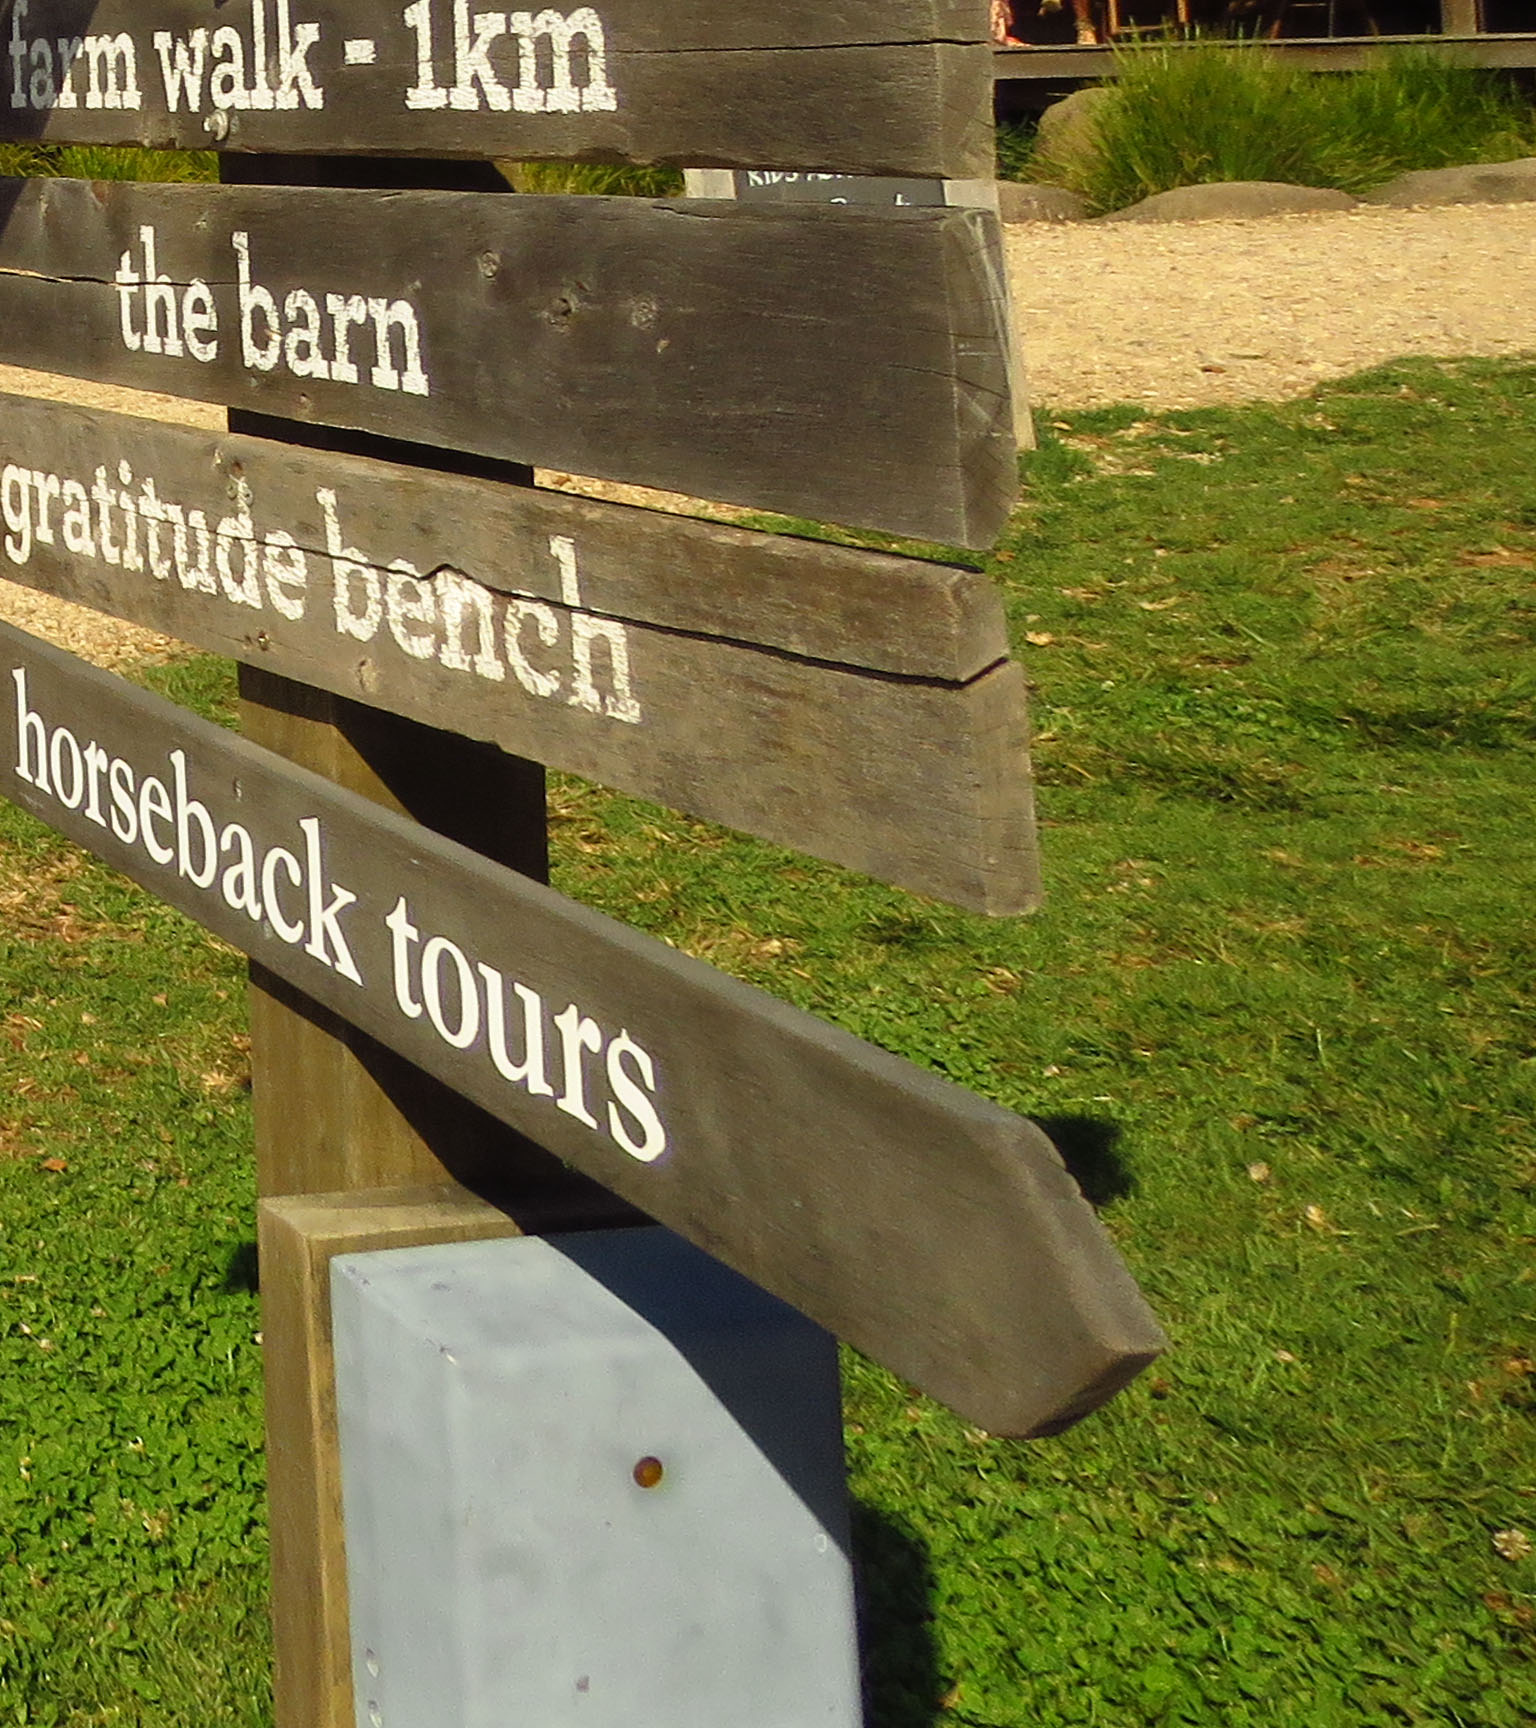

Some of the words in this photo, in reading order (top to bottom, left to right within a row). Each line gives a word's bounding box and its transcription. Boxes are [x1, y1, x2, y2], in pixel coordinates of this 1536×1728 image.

[115, 225, 218, 362] the
[234, 231, 429, 397] barn
[0, 459, 308, 621] gratitude
[317, 488, 644, 724] bench
[9, 667, 364, 987] horseback
[386, 894, 668, 1162] tours
